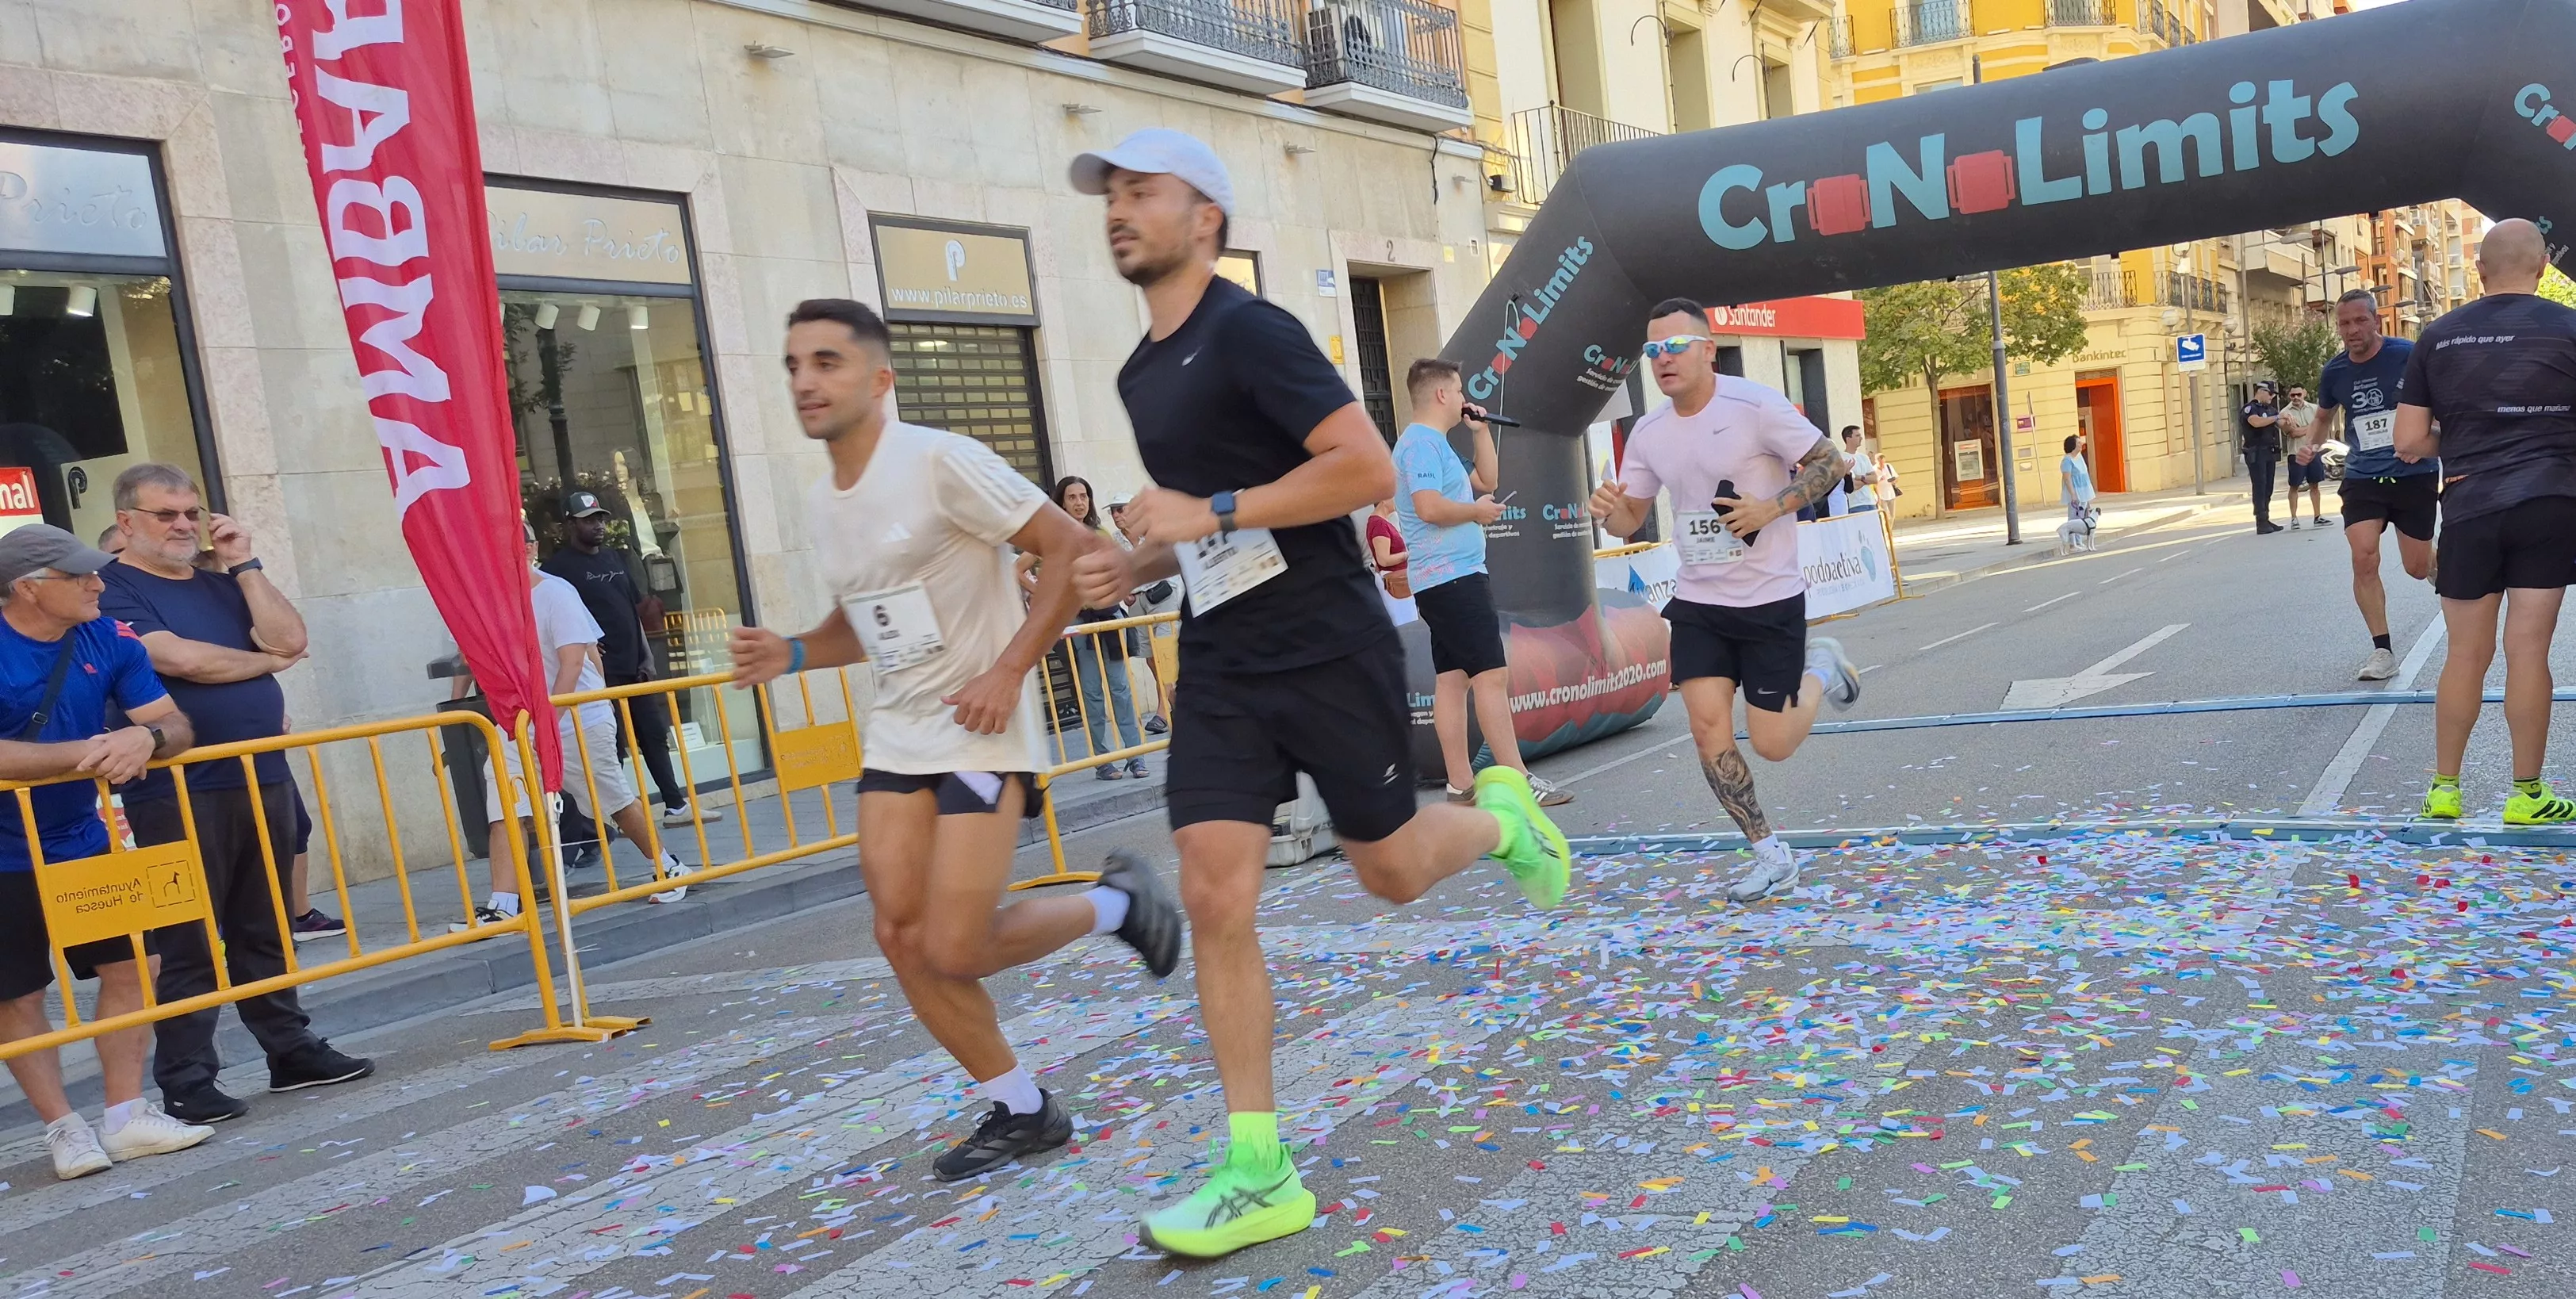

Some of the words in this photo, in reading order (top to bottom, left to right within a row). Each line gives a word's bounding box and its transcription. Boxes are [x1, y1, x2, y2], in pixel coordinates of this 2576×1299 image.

[582, 217, 679, 263] Prieto
[1386, 239, 1396, 262] 2
[891, 285, 1028, 310] www.pilarprieto.es
[1728, 304, 1777, 328] Santander
[2478, 335, 2495, 344] que
[2365, 418, 2388, 431] 187
[1689, 519, 1721, 535] 156
[873, 604, 891, 627] 6
[1510, 658, 1667, 714] www.cronolimits2020.com
